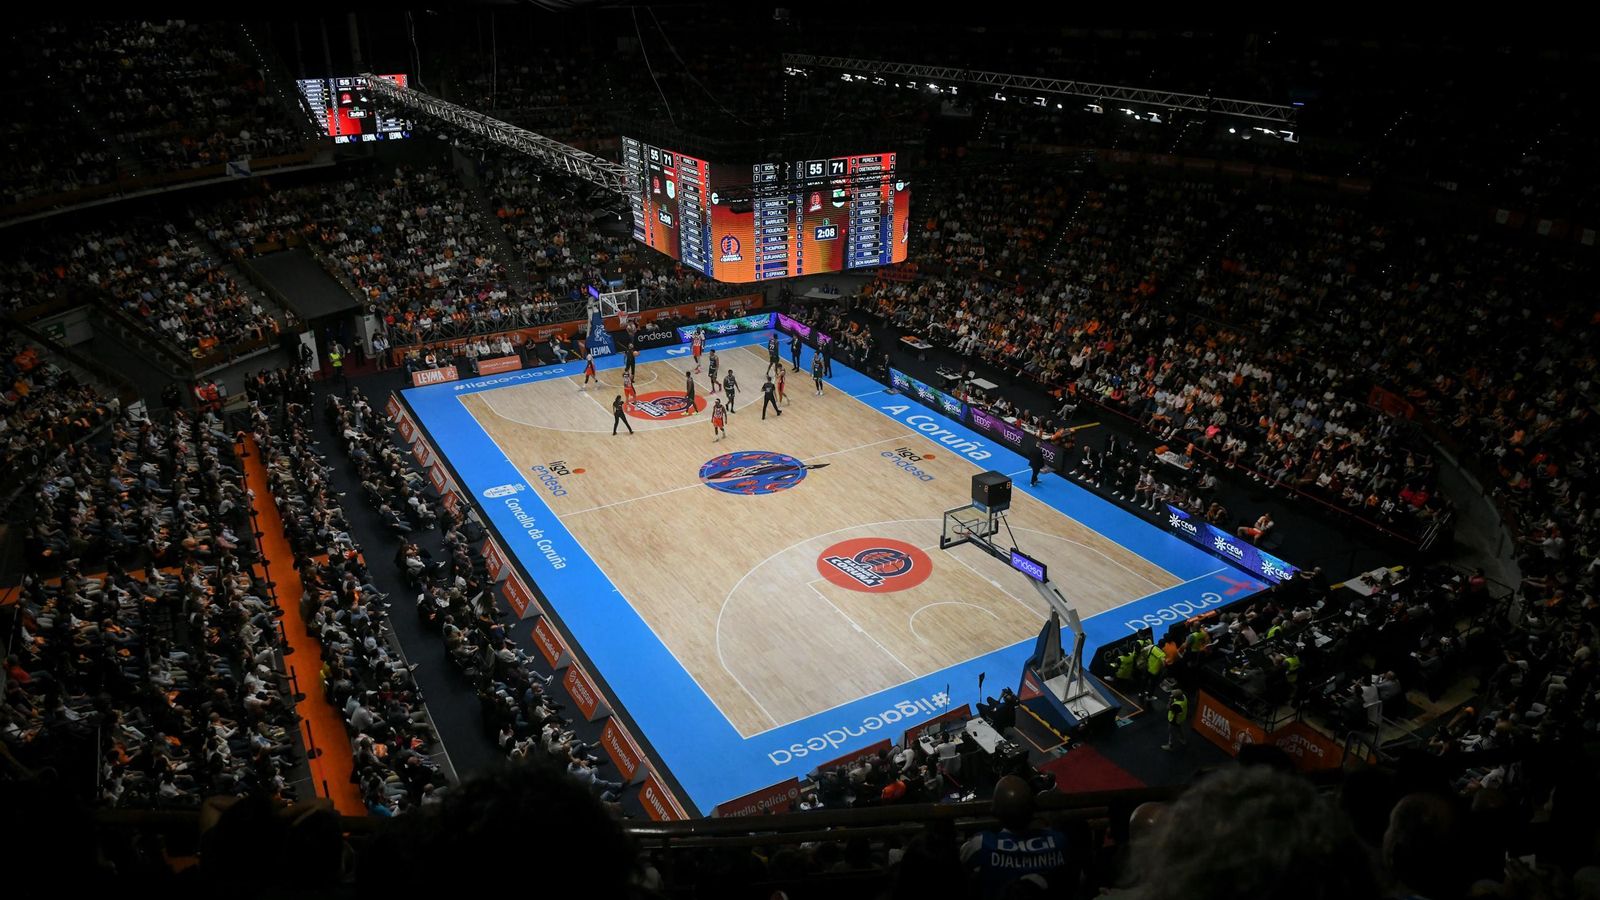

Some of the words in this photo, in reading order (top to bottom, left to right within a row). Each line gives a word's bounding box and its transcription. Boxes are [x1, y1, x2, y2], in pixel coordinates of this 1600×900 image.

[650, 149, 659, 161] 55
[663, 154, 672, 166] 71
[809, 163, 822, 175] 55
[832, 162, 844, 174] 71
[660, 212, 671, 224] 2:08
[817, 228, 835, 238] 2:08
[638, 331, 672, 343] endesa
[590, 345, 611, 356] LEYMA
[417, 370, 445, 384] LEYMA
[454, 367, 564, 390] #ligaendesa
[882, 404, 911, 416] A
[906, 414, 992, 461] Coruña
[894, 446, 924, 461] liga
[548, 460, 571, 476] liga
[880, 450, 936, 482] endesa
[531, 465, 568, 498] endesa
[504, 498, 536, 530] Concello
[530, 528, 544, 539] da
[1180, 520, 1197, 533] CEGA
[1226, 543, 1243, 557] CEGA
[536, 539, 567, 571] Coruña
[1012, 556, 1042, 577] endesa
[1124, 592, 1222, 631] endesa
[767, 691, 951, 766] #ligaendesa
[1202, 705, 1232, 734] LEYMA
[757, 792, 787, 811] Galicia
[997, 836, 1056, 852] DIGI
[991, 851, 1065, 869] DJALMINHA
